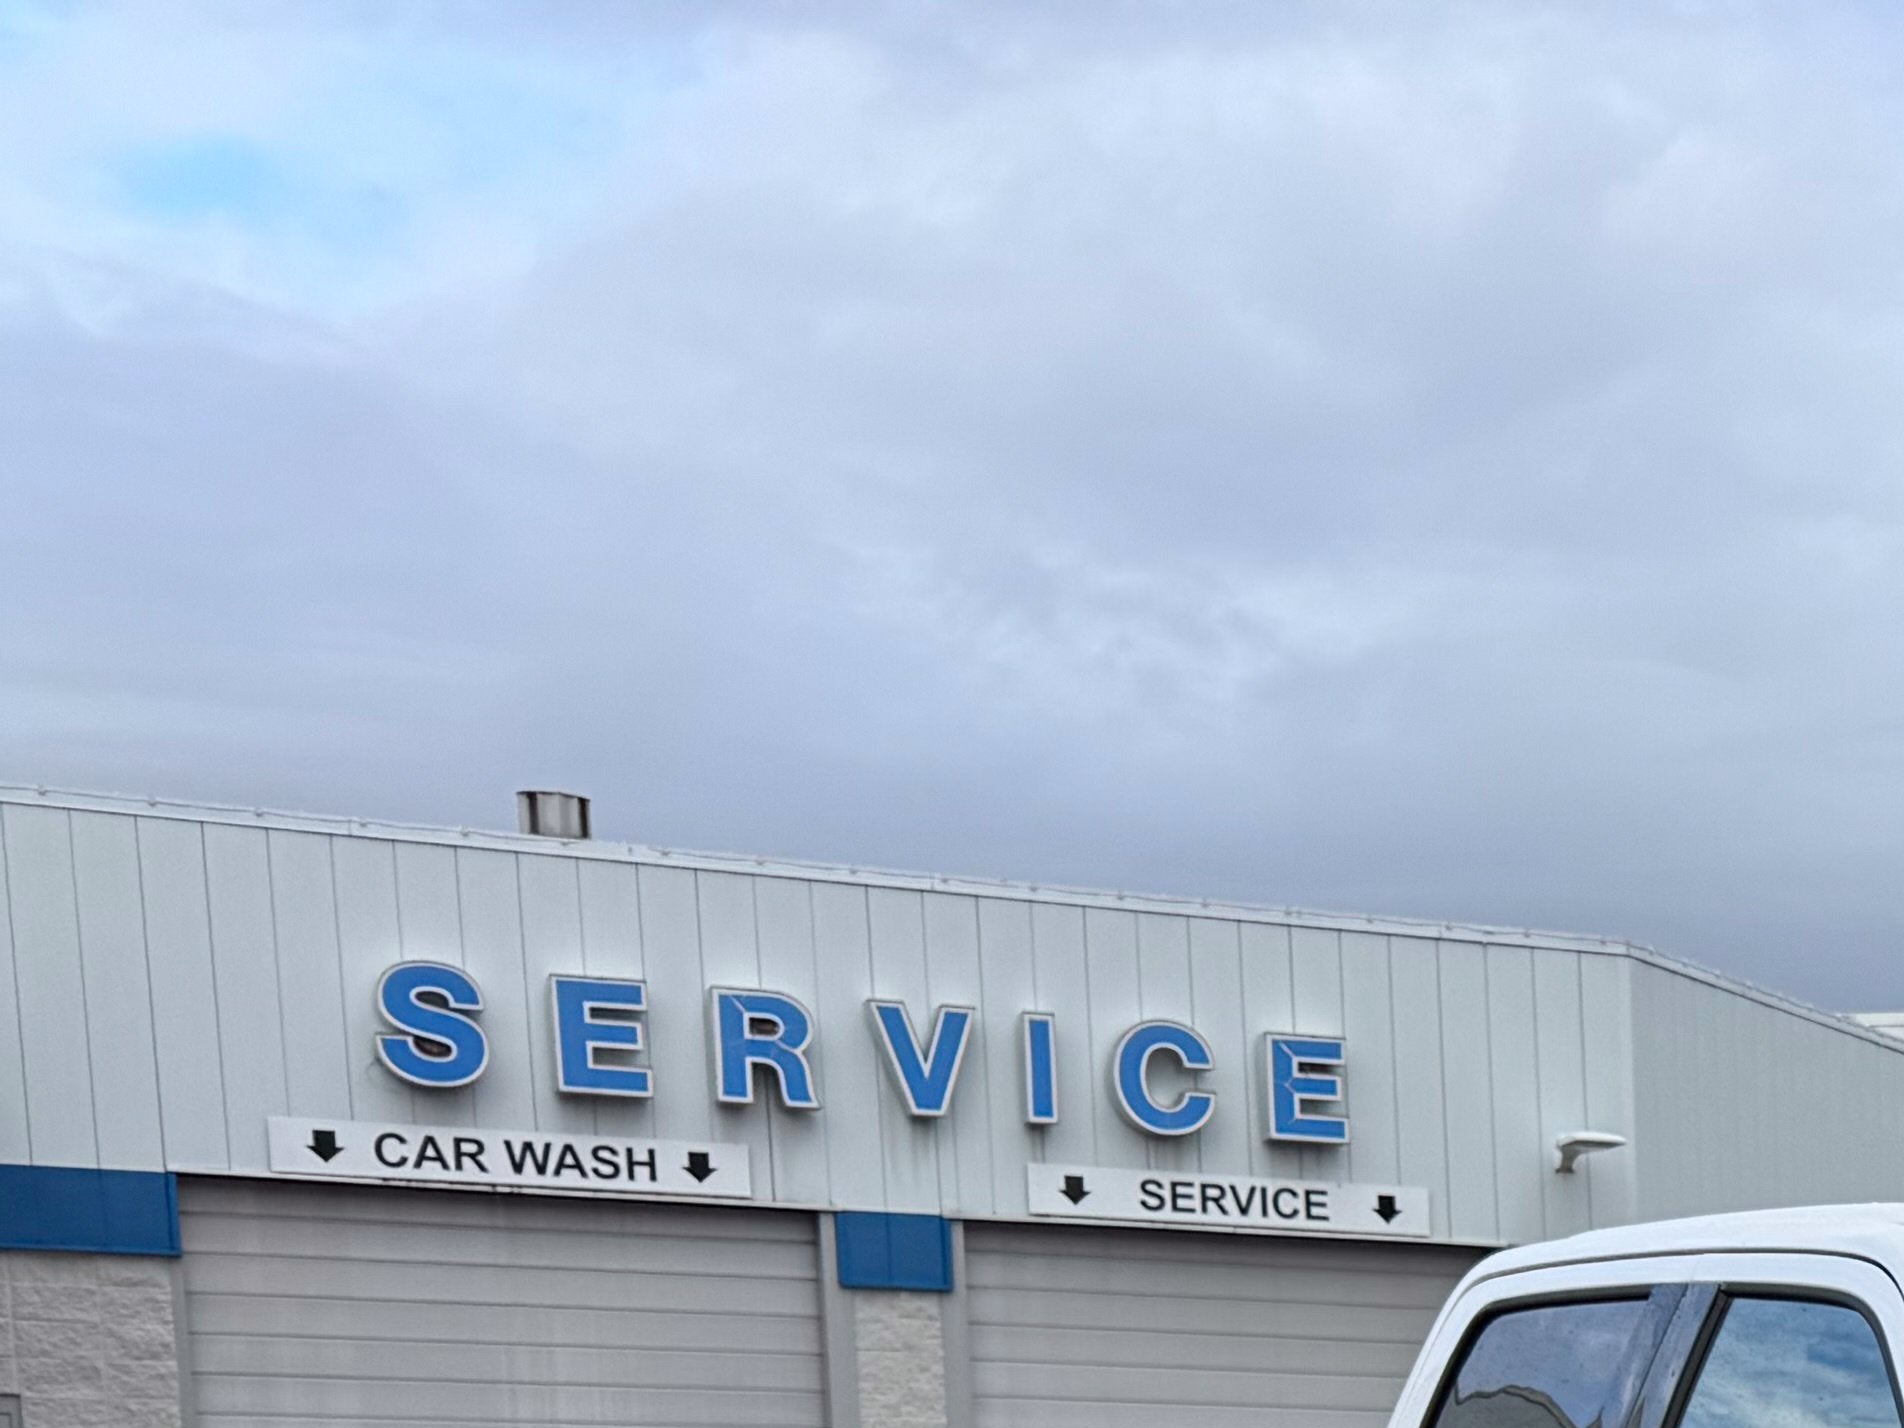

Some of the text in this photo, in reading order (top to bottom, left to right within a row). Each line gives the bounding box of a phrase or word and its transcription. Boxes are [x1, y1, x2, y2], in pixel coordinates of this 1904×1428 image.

[375, 959, 1350, 1145] SERVICE
[374, 1131, 658, 1182] CAR WASH
[1139, 1178, 1331, 1222] SERVICE
